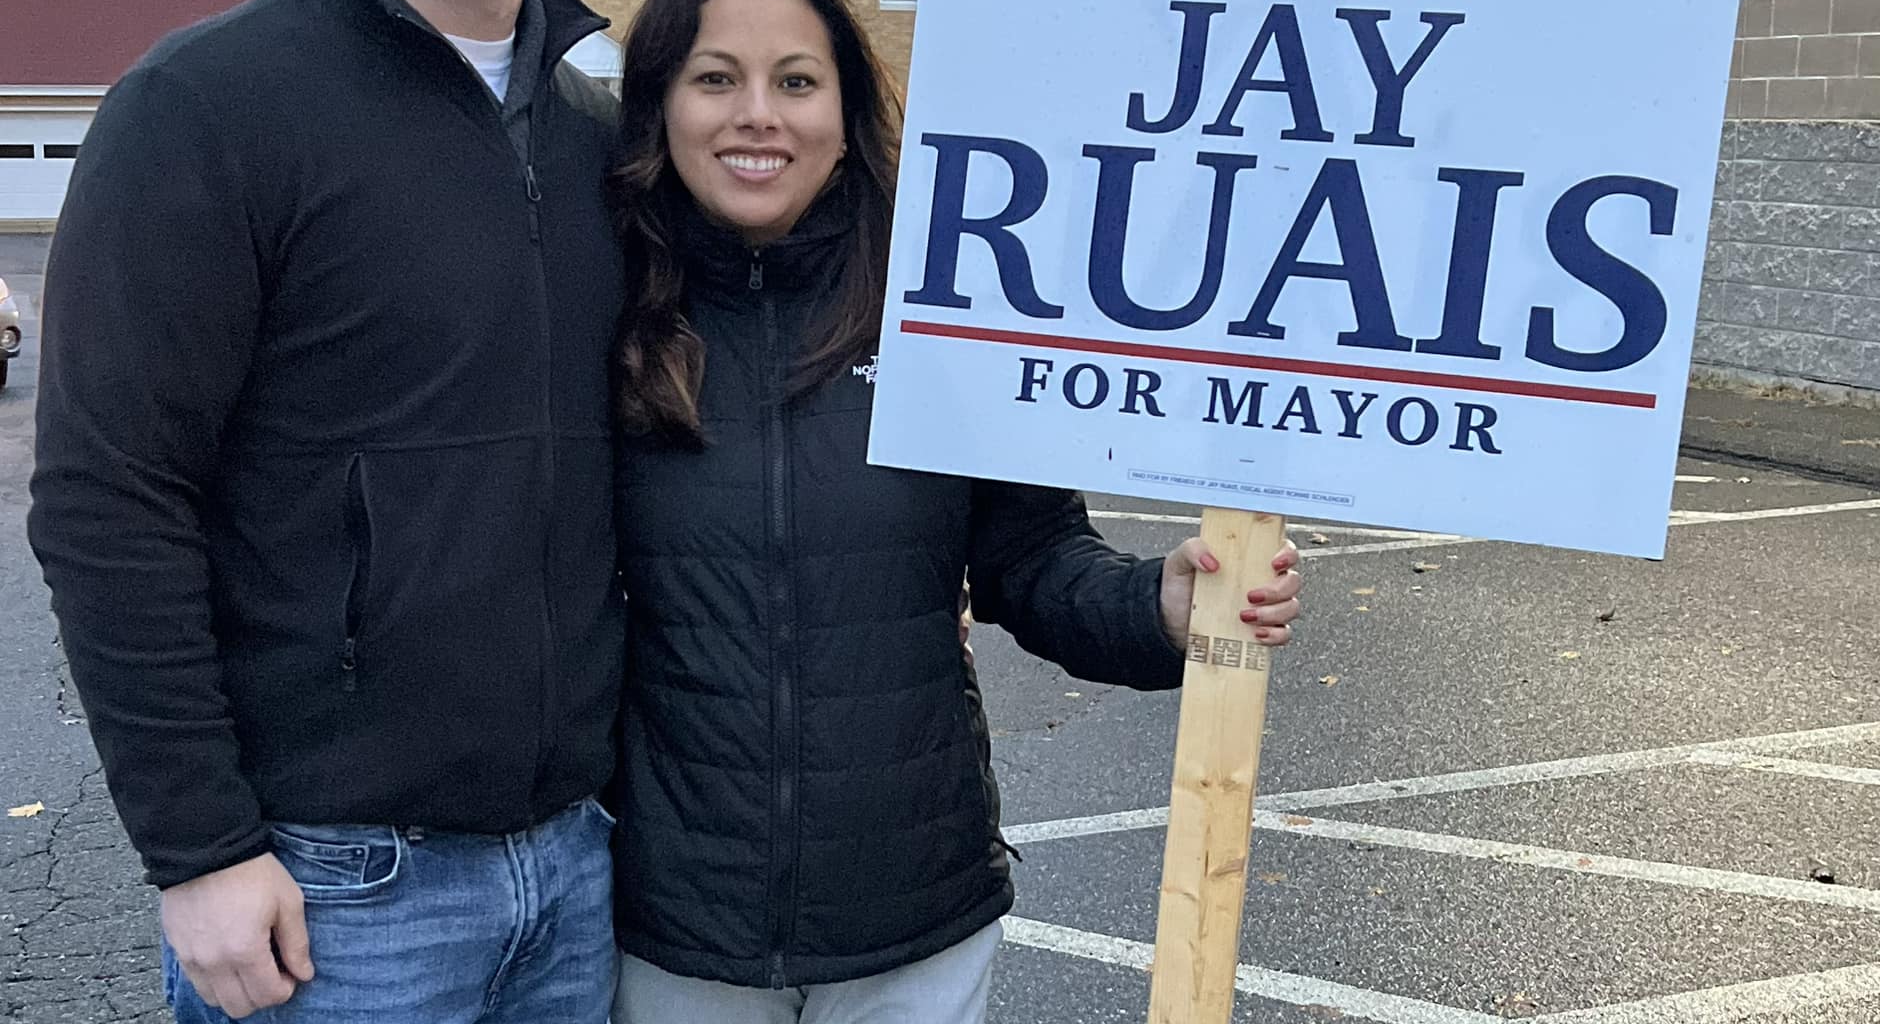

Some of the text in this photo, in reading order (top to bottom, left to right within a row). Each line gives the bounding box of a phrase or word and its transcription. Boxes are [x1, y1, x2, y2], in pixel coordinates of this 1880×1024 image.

[1126, 0, 1466, 148] JAY
[903, 132, 1679, 373] RUAIS
[852, 365, 878, 376] NOR
[1014, 357, 1503, 455] FOR MAYOR
[1147, 473, 1160, 481] FOR
[1170, 476, 1195, 485] FRIENDS
[1207, 480, 1218, 488] JAY
[1263, 487, 1284, 495] AGENT
